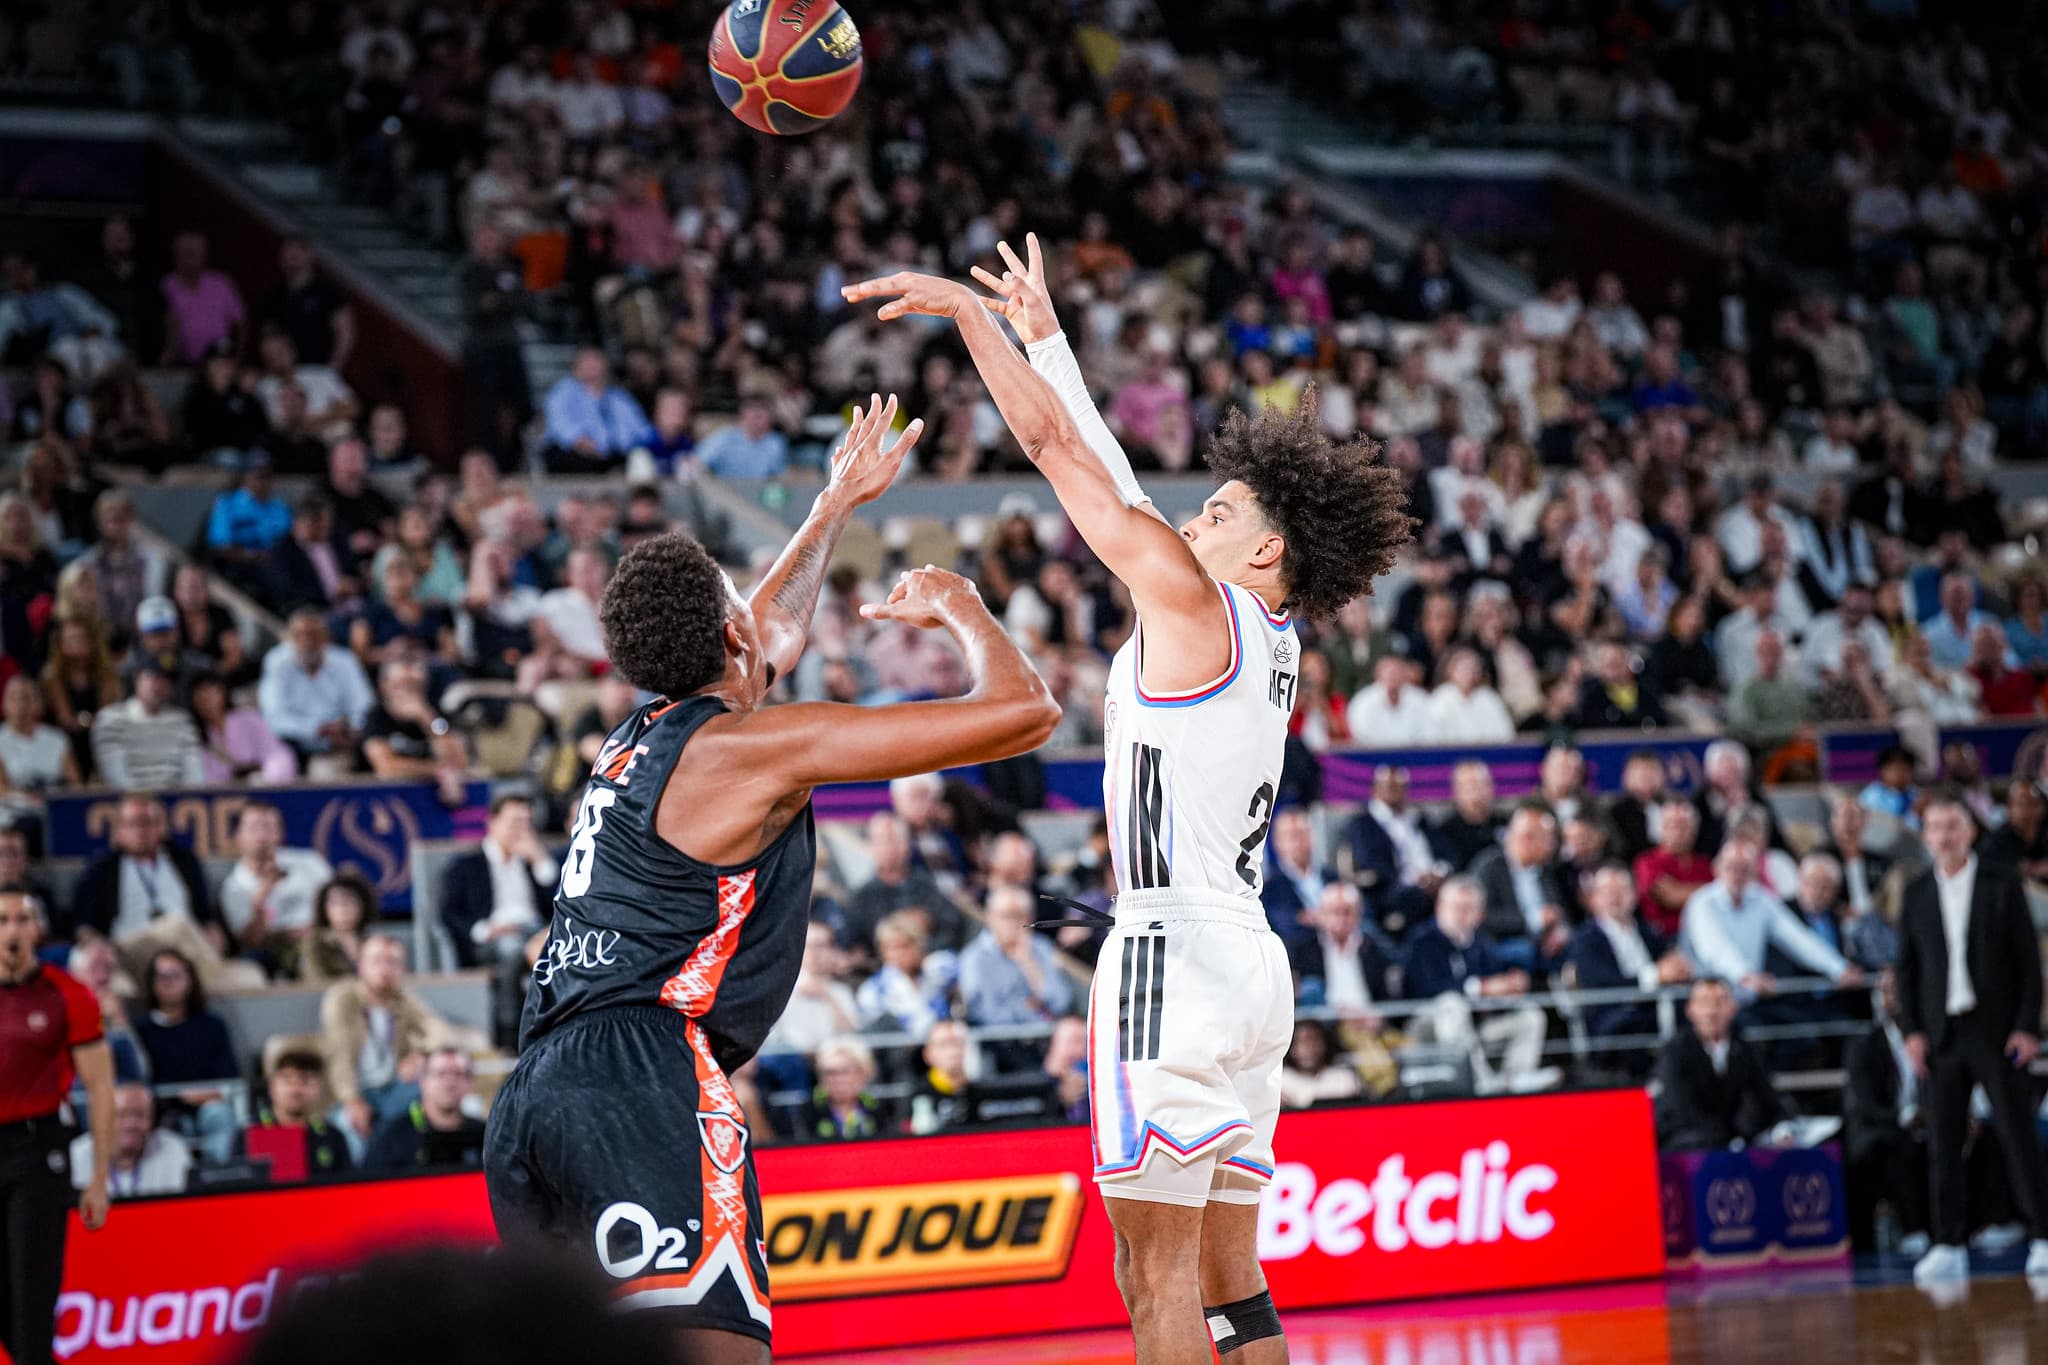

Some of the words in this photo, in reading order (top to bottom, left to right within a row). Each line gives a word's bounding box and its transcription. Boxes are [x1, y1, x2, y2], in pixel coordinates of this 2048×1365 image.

[767, 1209, 872, 1265] ON
[878, 1195, 1054, 1258] JOUE
[1257, 1140, 1558, 1261] Betclic
[51, 1267, 281, 1359] Quand
